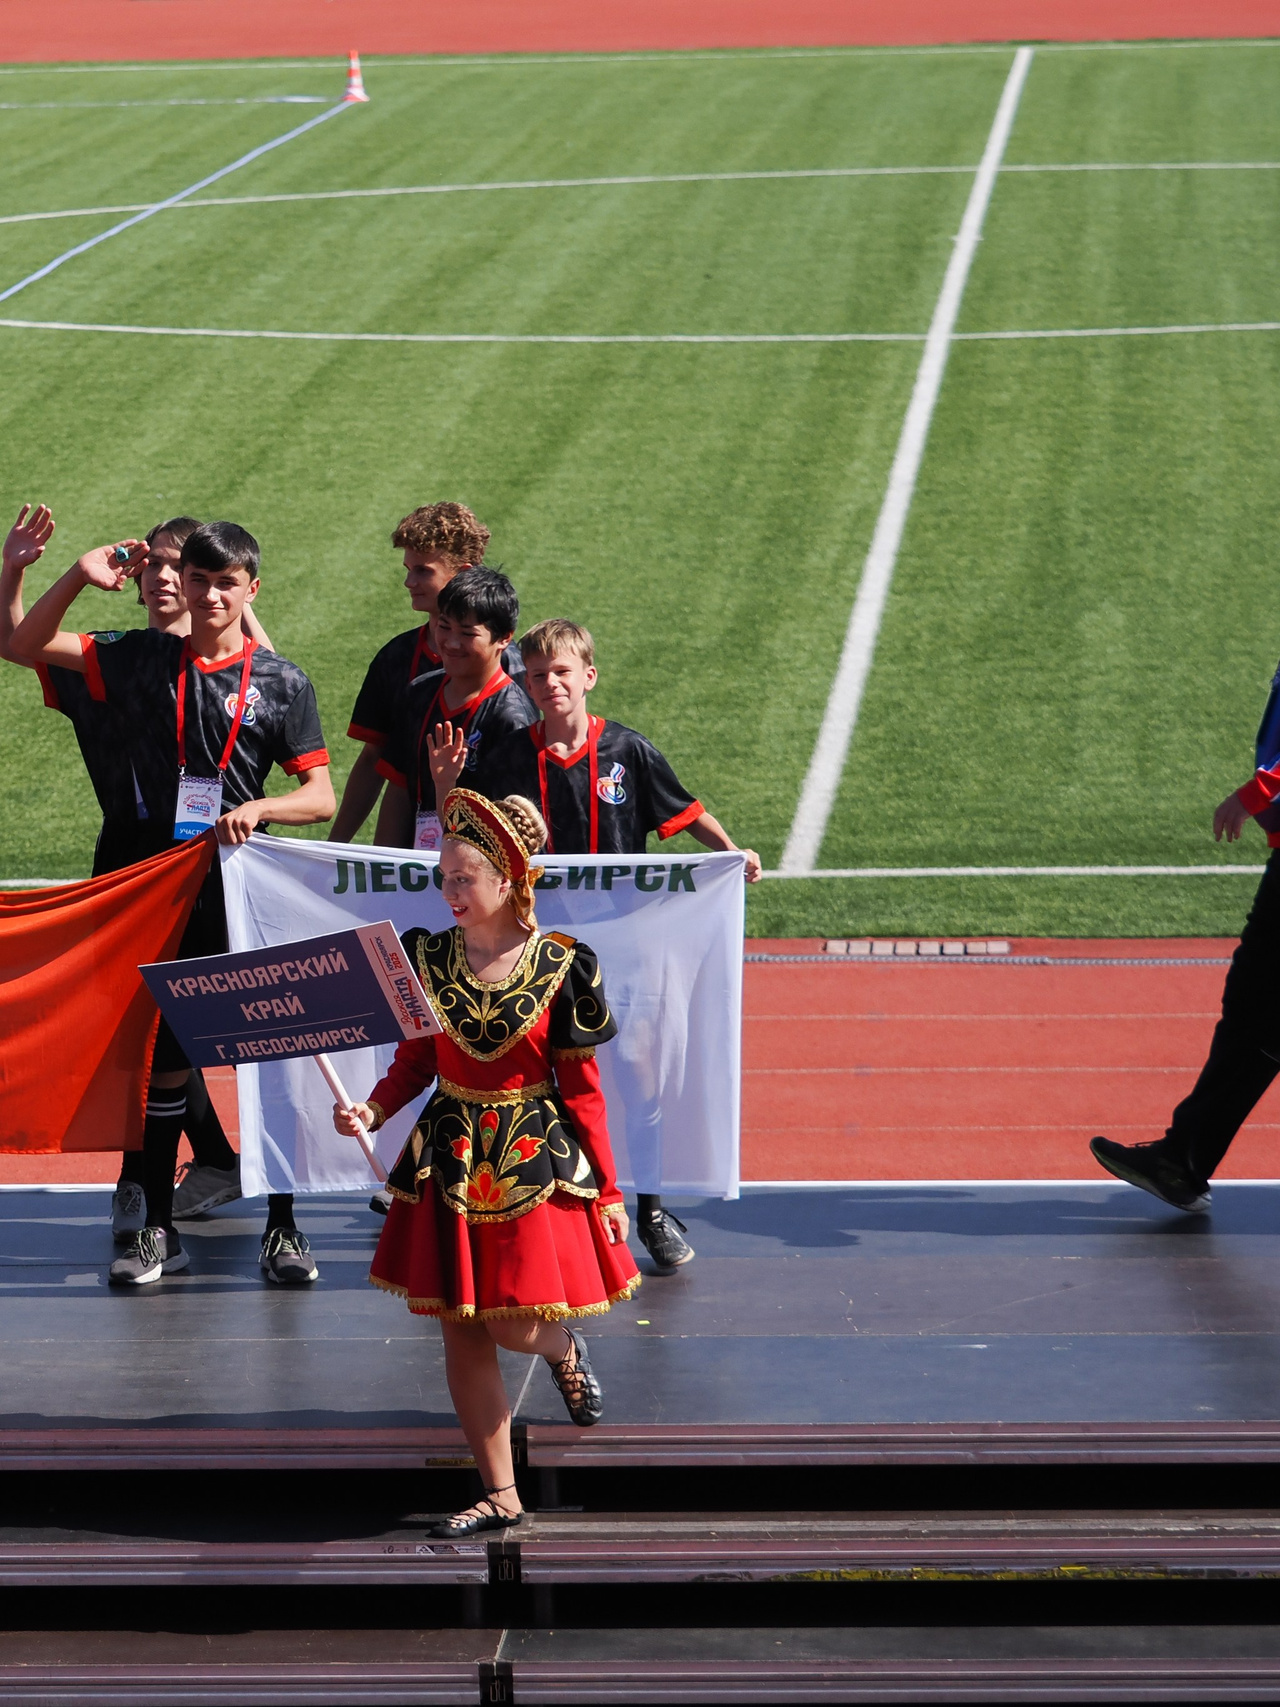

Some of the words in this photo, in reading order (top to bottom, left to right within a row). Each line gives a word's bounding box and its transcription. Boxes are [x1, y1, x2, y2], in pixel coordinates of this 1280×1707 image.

[333, 858, 699, 894] ЛЕСБИРСК
[166, 947, 350, 998] КРАСНОЯРСКИЙ
[389, 952, 403, 970] 2025
[239, 992, 306, 1022] КРАЙ
[394, 976, 426, 1018] ЛАПТА
[237, 1025, 370, 1058] ЛЕСОСИБИРСК
